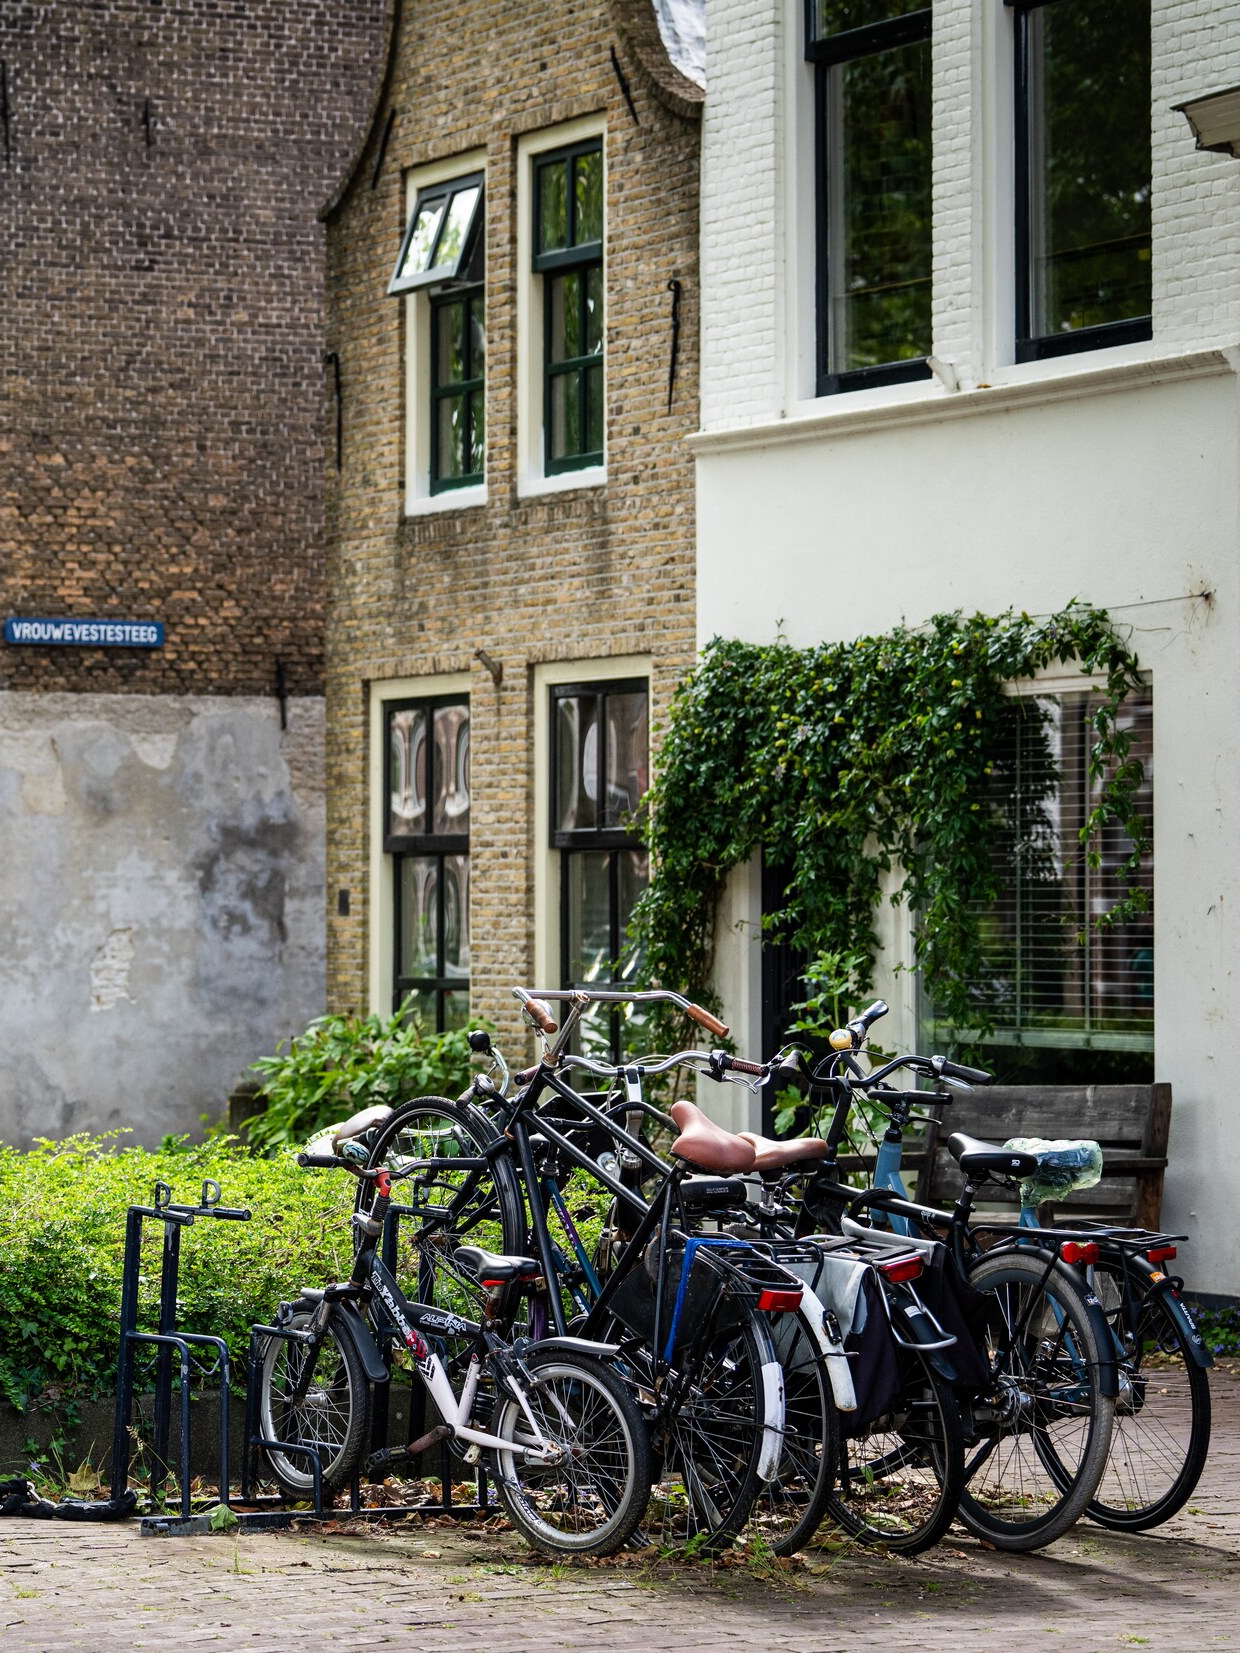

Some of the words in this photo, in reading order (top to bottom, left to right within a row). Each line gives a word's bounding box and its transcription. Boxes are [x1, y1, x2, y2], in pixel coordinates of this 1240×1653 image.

[12, 622, 158, 643] VROUWEVESTESTEEG
[419, 1312, 468, 1333] ALPINA
[1179, 1302, 1197, 1330] SPARTA
